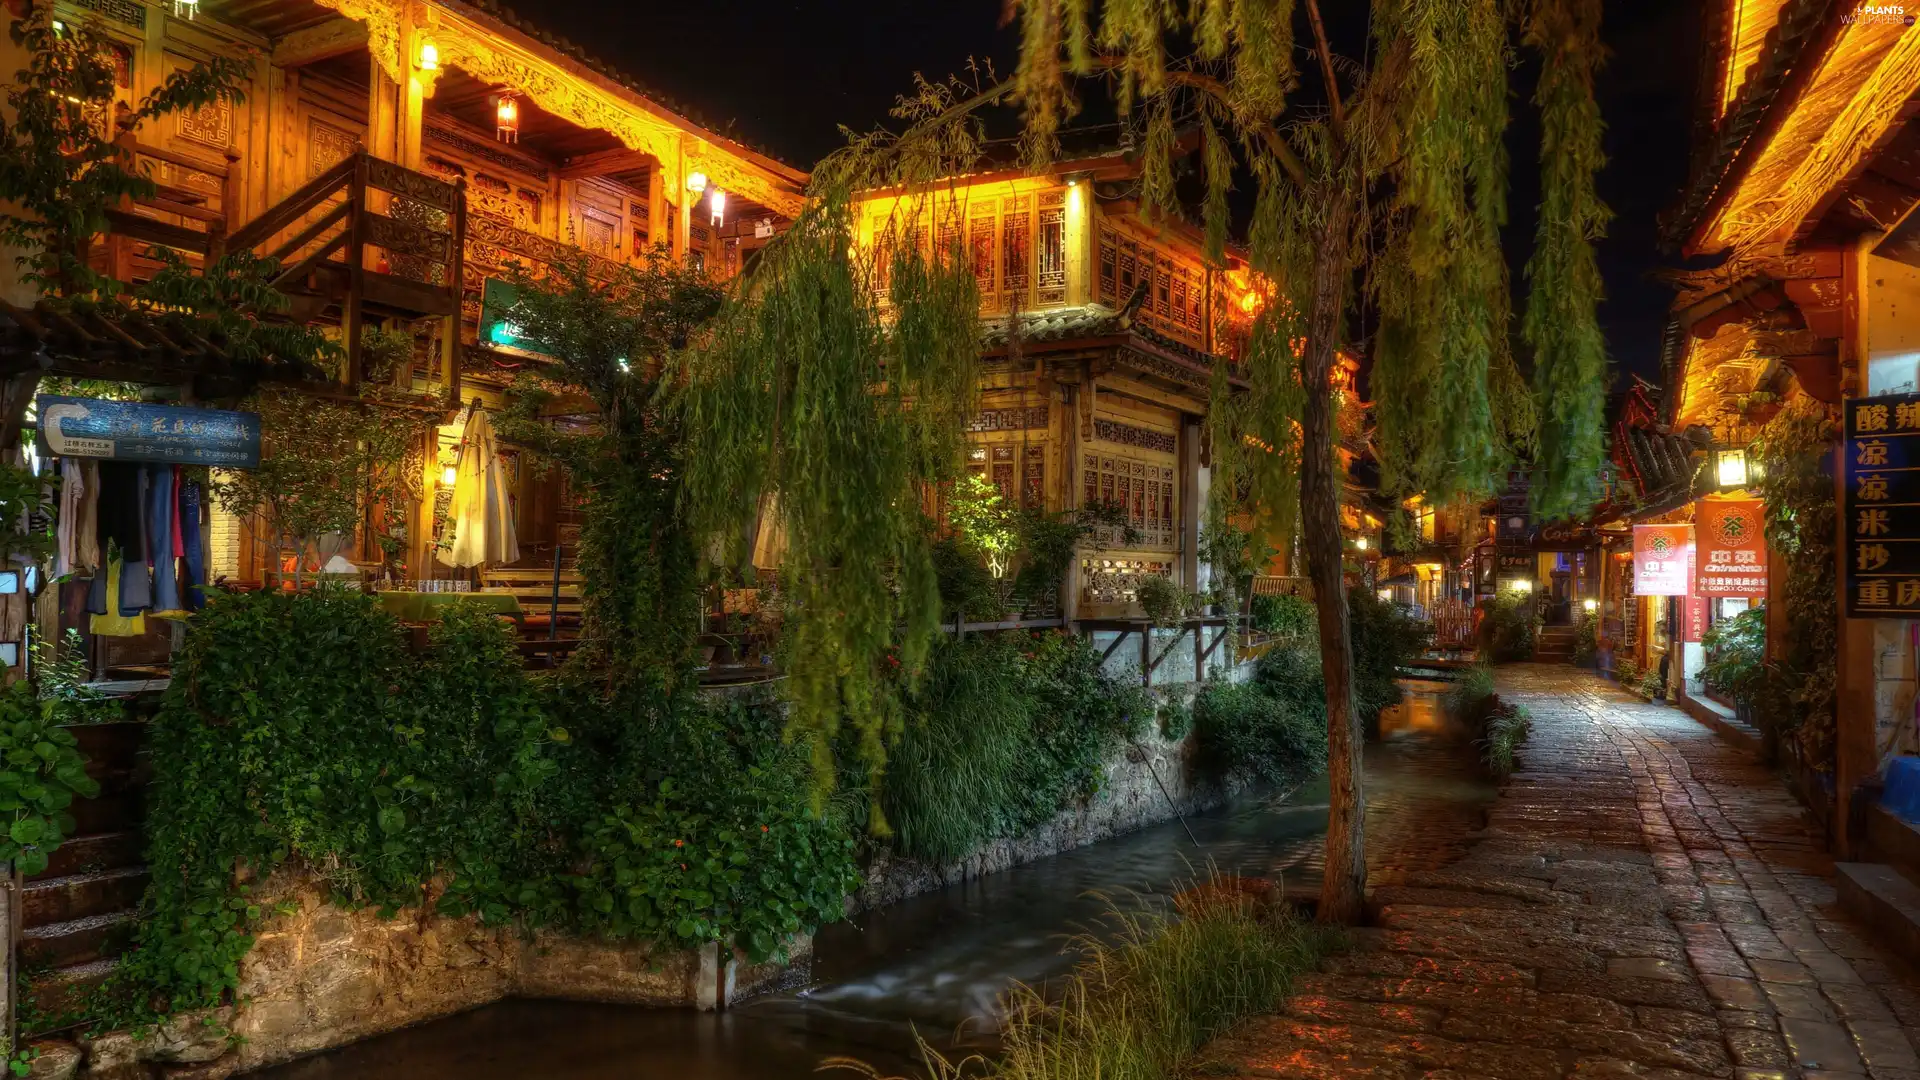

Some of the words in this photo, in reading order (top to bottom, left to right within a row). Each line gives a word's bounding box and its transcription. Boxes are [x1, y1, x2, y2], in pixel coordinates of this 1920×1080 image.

[1856, 440, 1889, 465] 凉
[1856, 474, 1890, 500] 凉
[1856, 508, 1890, 536] 米
[1856, 544, 1891, 570] 抄
[1857, 579, 1920, 606] 重庆
